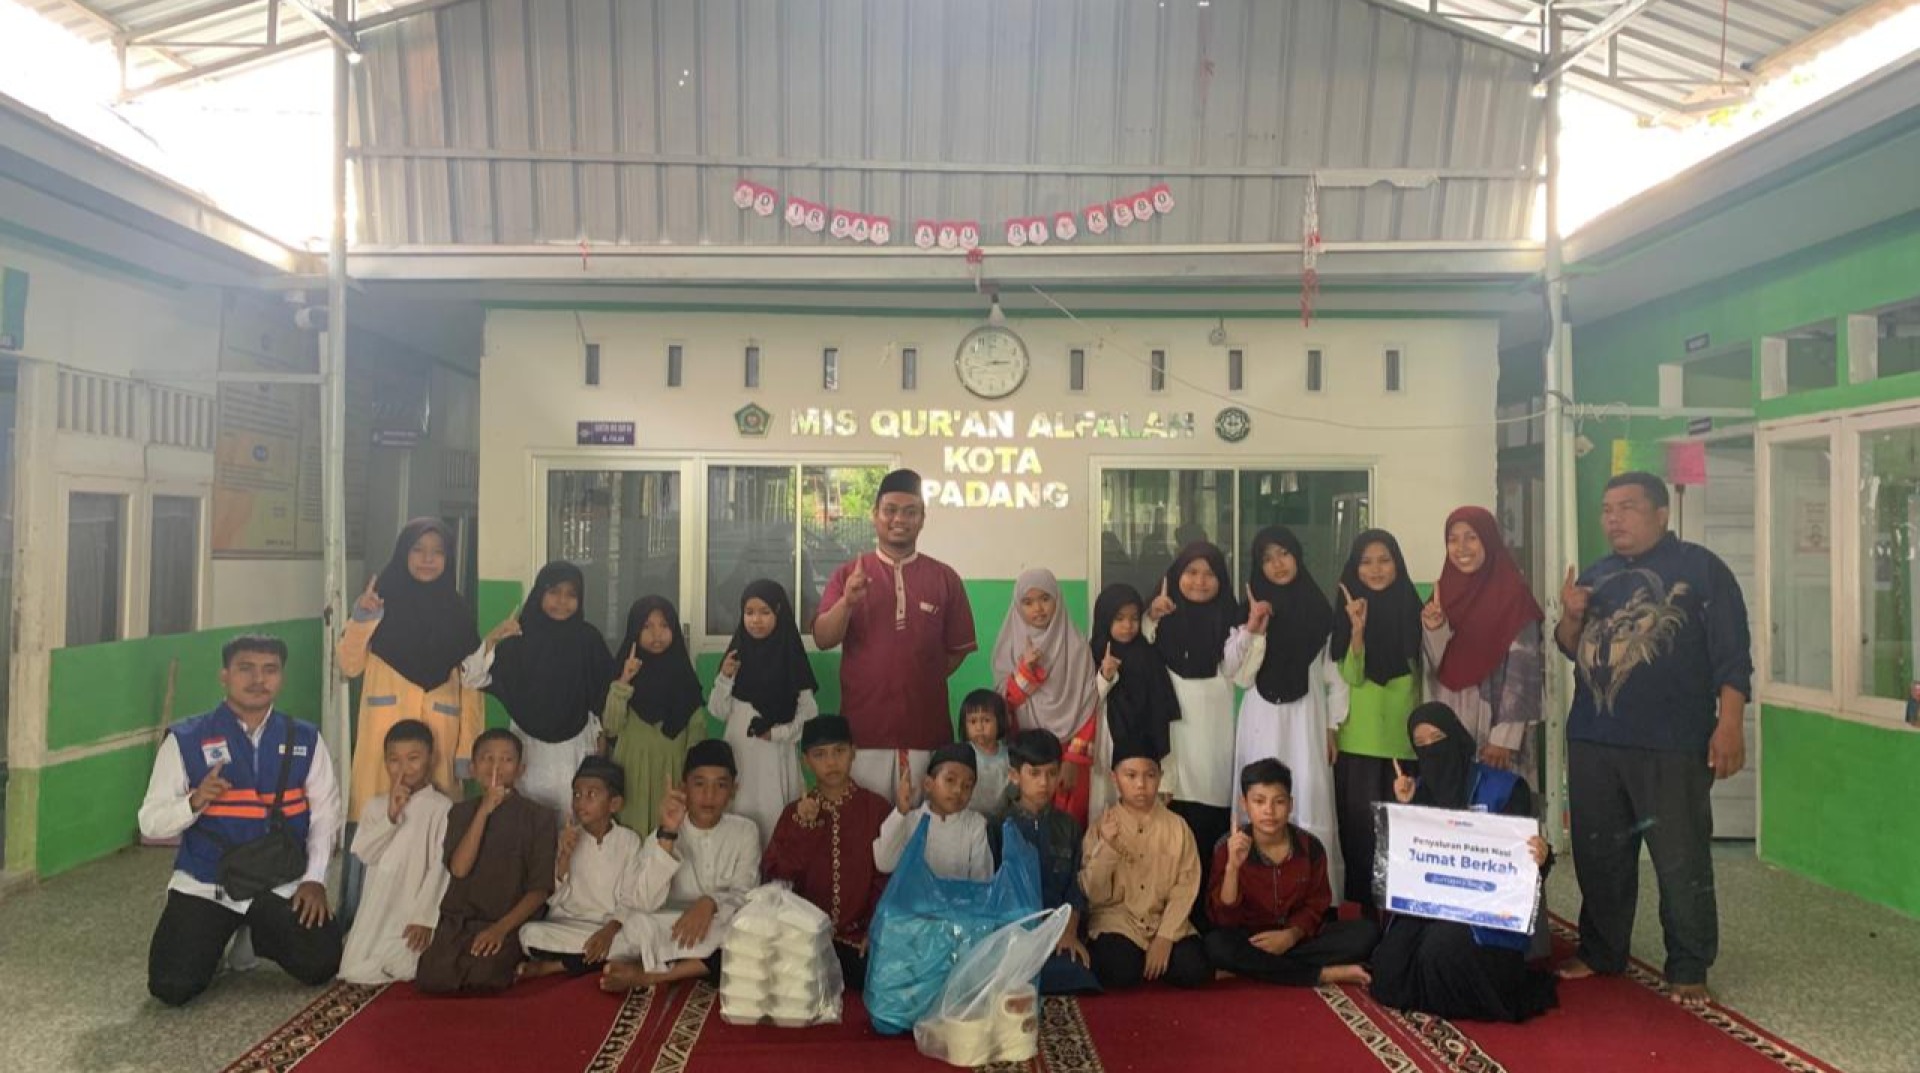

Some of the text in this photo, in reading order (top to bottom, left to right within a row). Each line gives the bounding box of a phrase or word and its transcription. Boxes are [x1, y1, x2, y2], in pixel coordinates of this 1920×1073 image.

[791, 408, 1195, 438] MIS QUR'AN ALFALAH
[944, 446, 1042, 474] KOTA
[921, 479, 1069, 508] PADANG
[1408, 848, 1519, 876] Jumat Berkah
